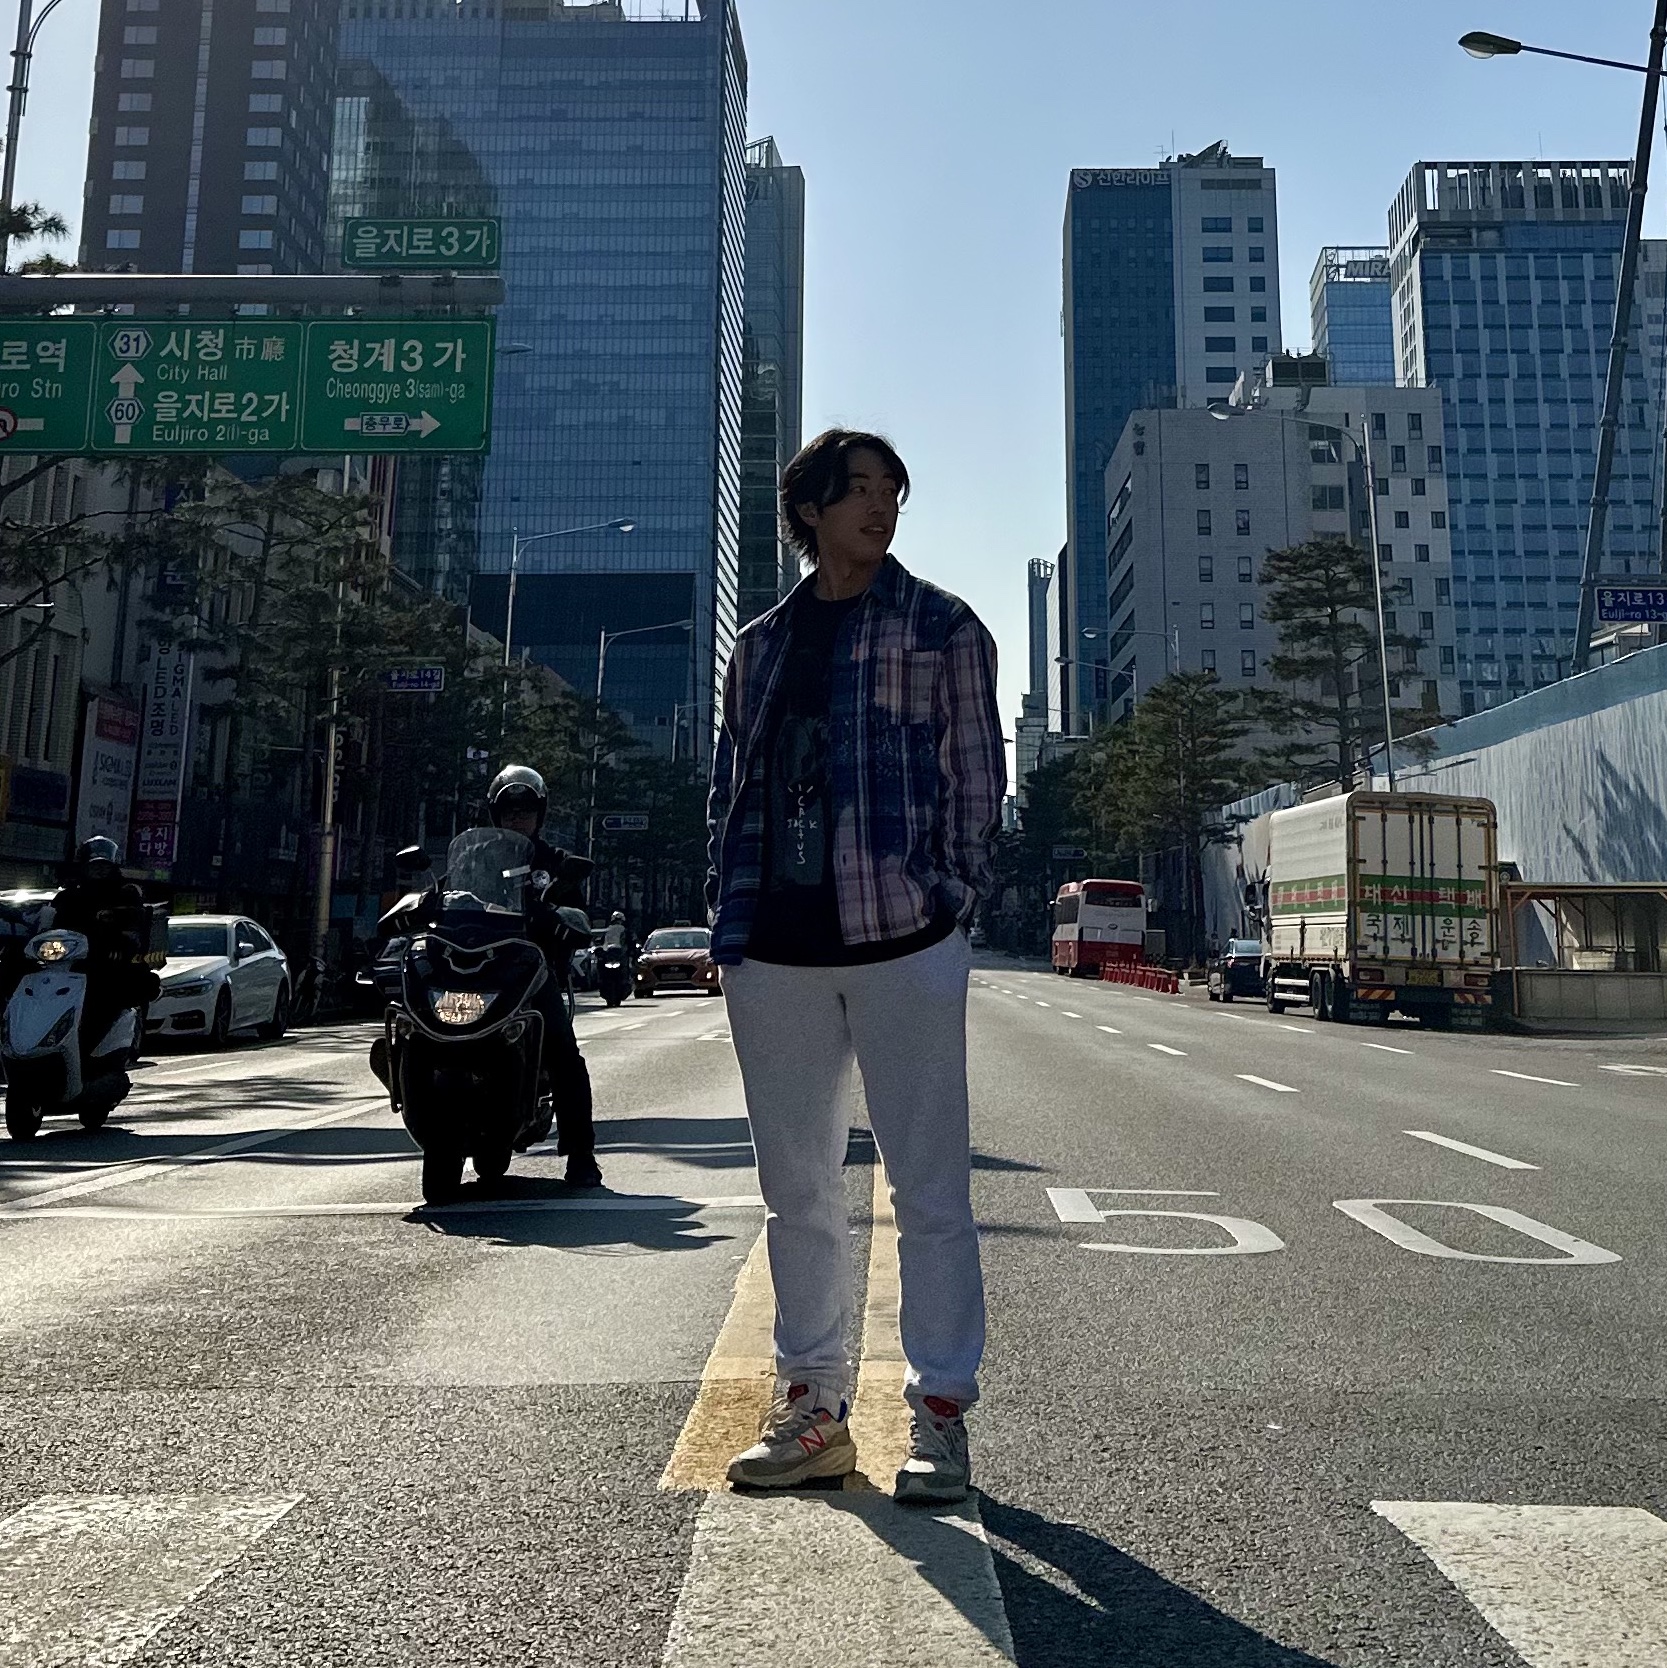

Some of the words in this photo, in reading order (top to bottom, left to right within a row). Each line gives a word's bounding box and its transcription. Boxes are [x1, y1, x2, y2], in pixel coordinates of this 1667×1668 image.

[1096, 170, 1170, 186] 신한라이프
[353, 226, 491, 258] 을지로3가
[118, 333, 142, 355] 31
[160, 329, 224, 361] 시청
[328, 338, 466, 372] 청계3가
[157, 364, 190, 384] City
[197, 364, 228, 381] Hall
[31, 378, 62, 398] Stn
[326, 377, 401, 404] Cheonggye
[405, 377, 466, 404] 3(sam)-ga
[114, 402, 136, 421] 60
[153, 391, 290, 422] 을지로2가
[364, 416, 405, 431] 충무로
[153, 425, 209, 445] Euljiro
[170, 701, 180, 736] LED
[139, 842, 168, 856] 다방
[1366, 913, 1409, 936] 국제
[1045, 1187, 1623, 1265] 50
